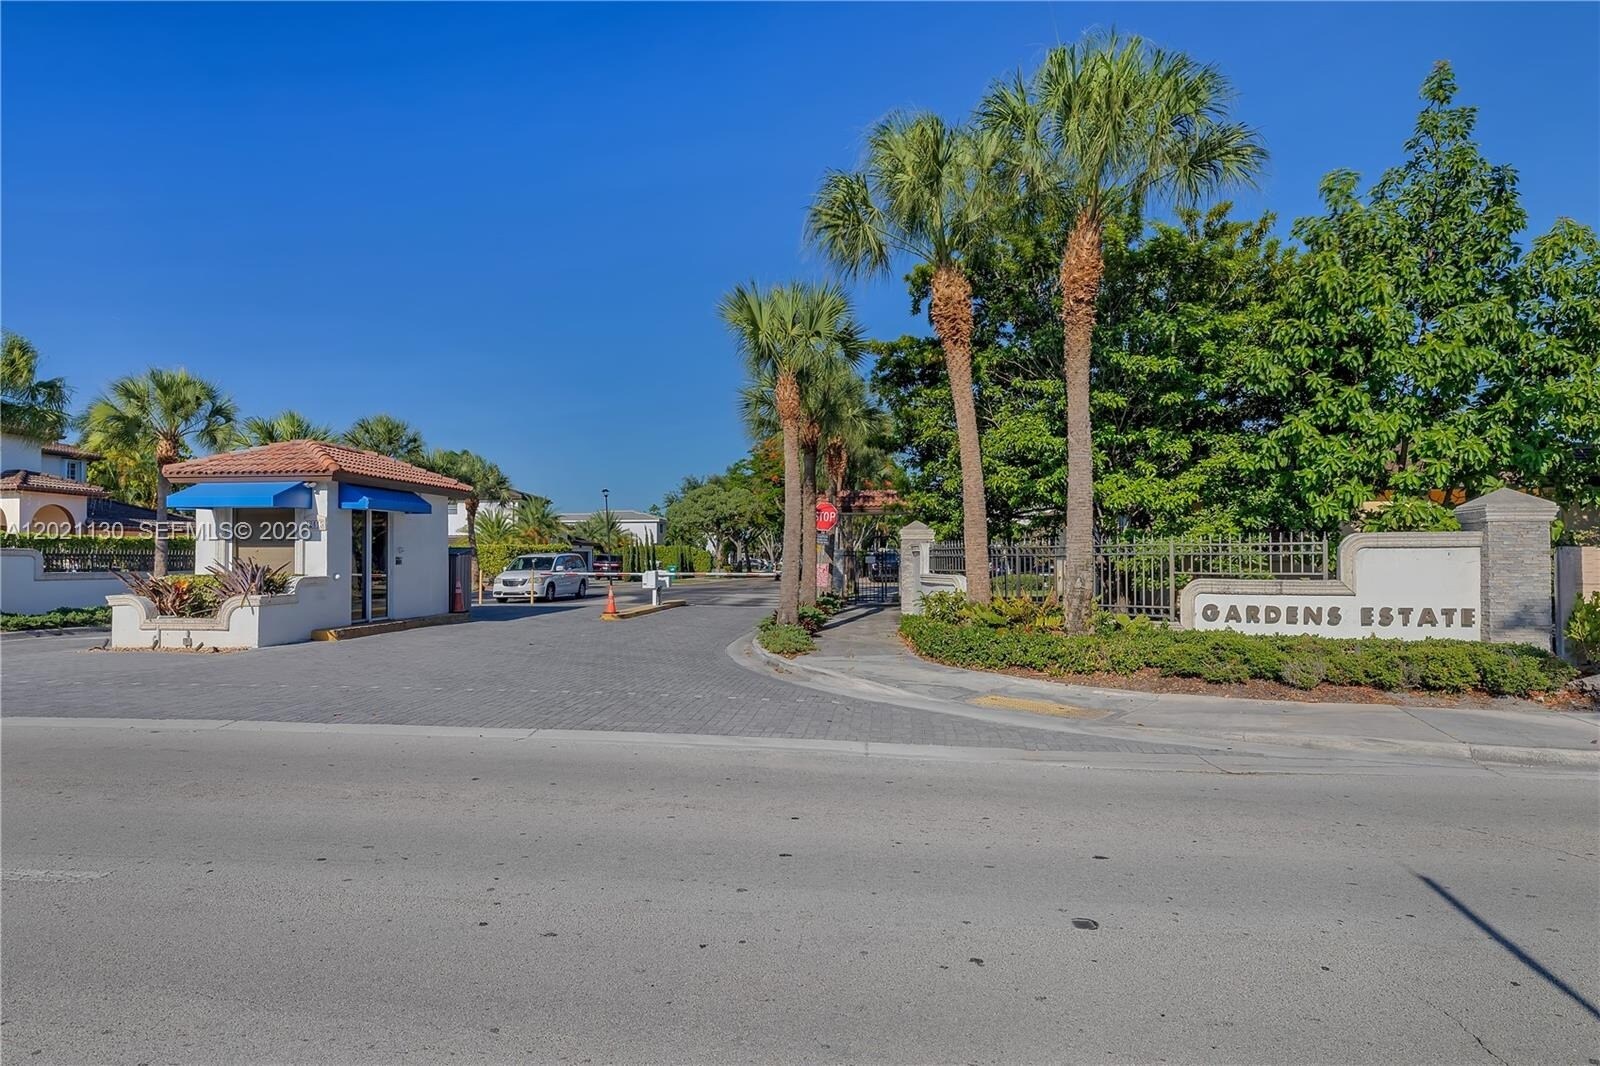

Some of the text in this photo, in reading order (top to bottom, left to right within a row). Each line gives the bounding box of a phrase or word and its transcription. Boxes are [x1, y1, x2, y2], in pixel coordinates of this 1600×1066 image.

[815, 511, 836, 522] STOP
[1202, 603, 1476, 628] GARDENS ESTATE
